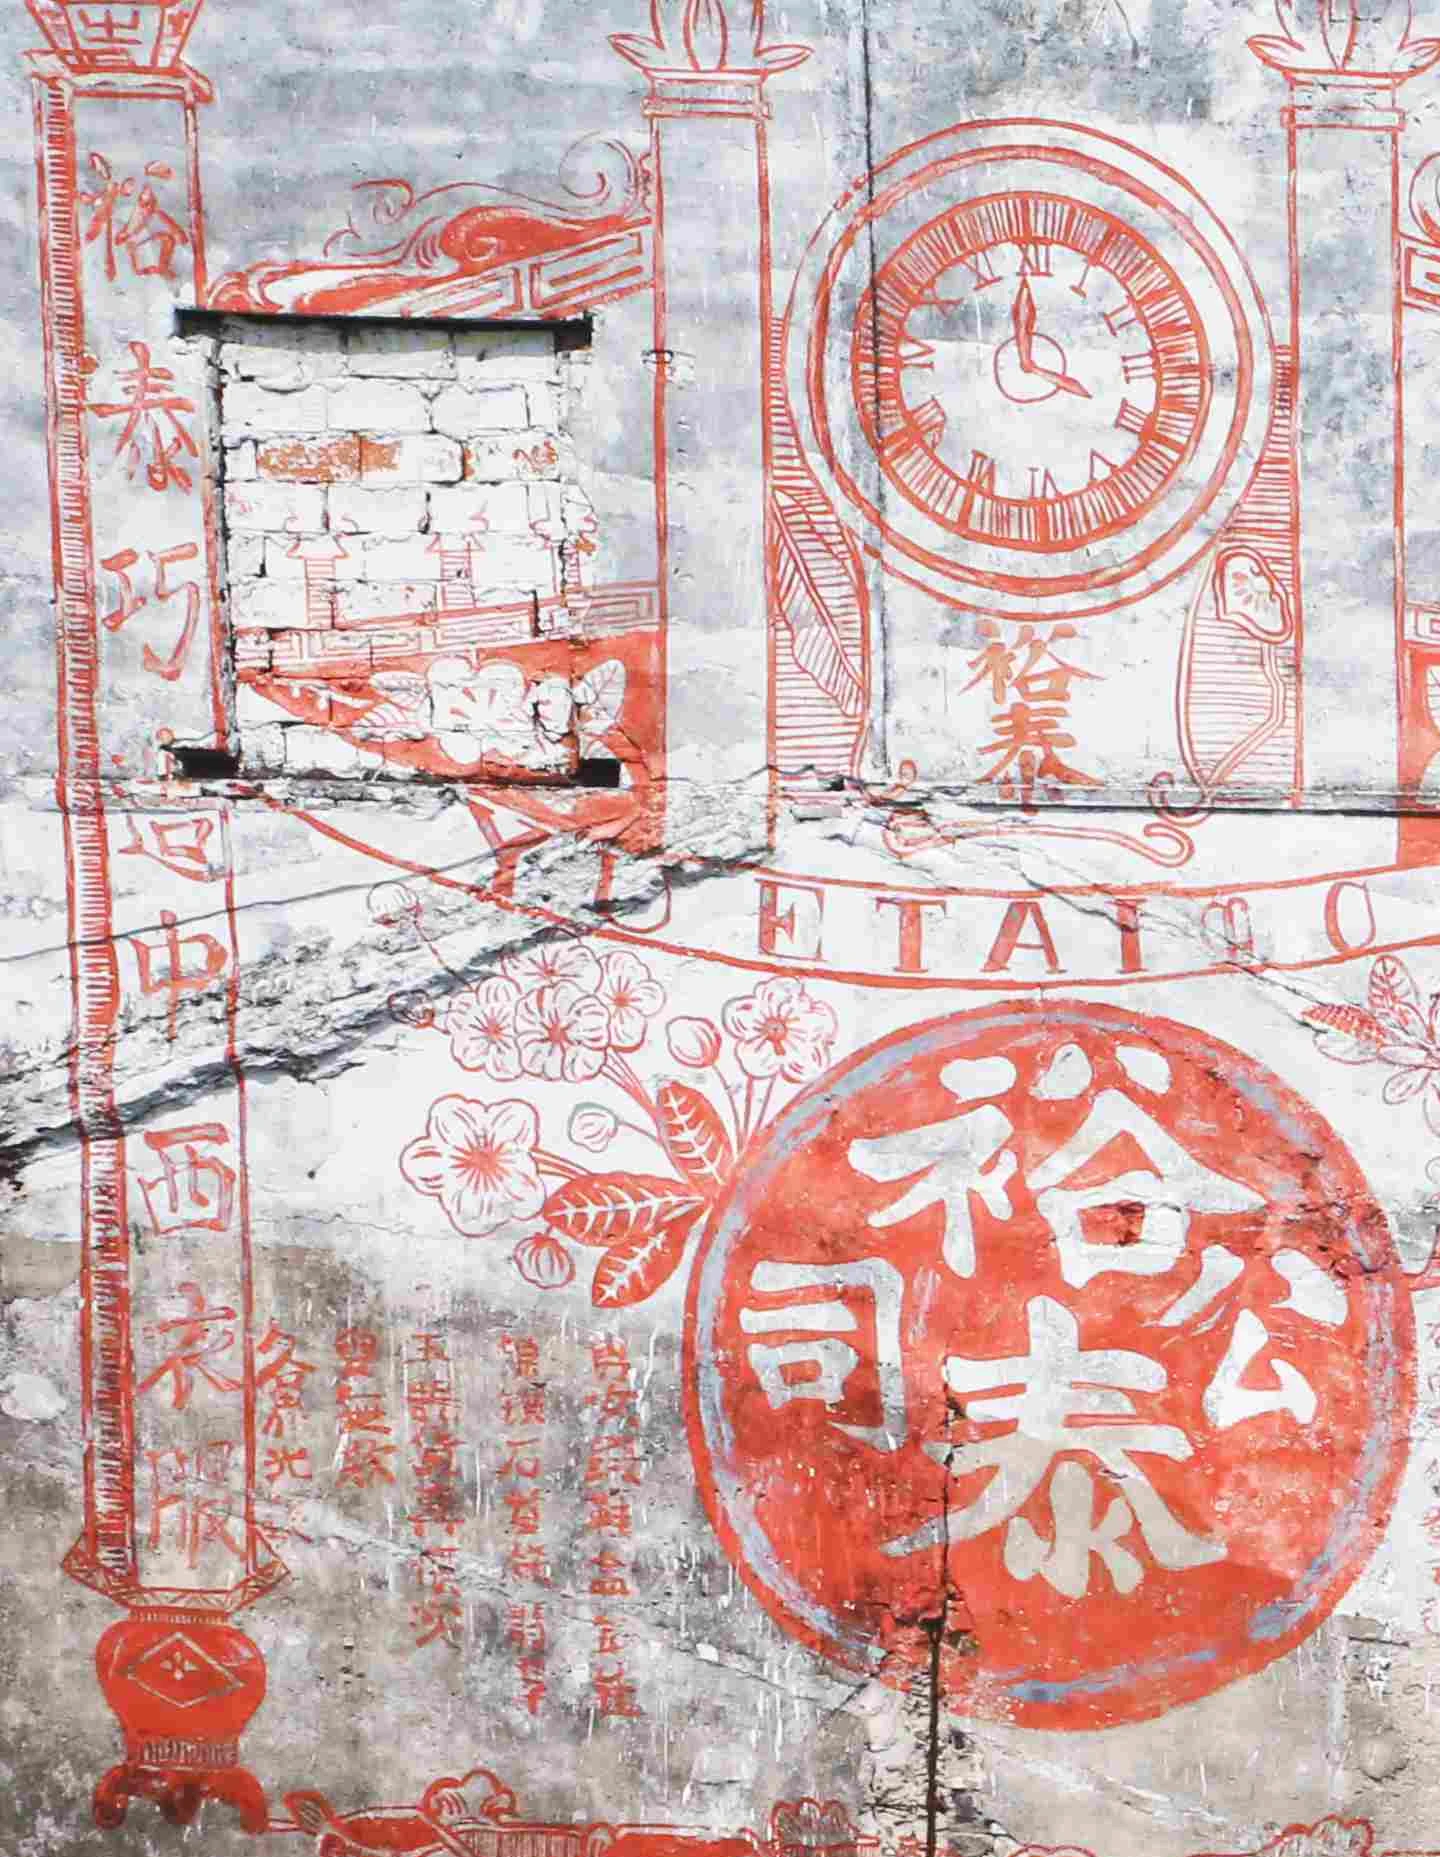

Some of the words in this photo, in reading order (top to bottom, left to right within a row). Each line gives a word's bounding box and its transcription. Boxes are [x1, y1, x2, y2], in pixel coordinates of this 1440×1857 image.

[955, 620, 1104, 815] 裕泰
[739, 1245, 1351, 1451] 公司
[848, 1042, 1268, 1597] 裕泰
